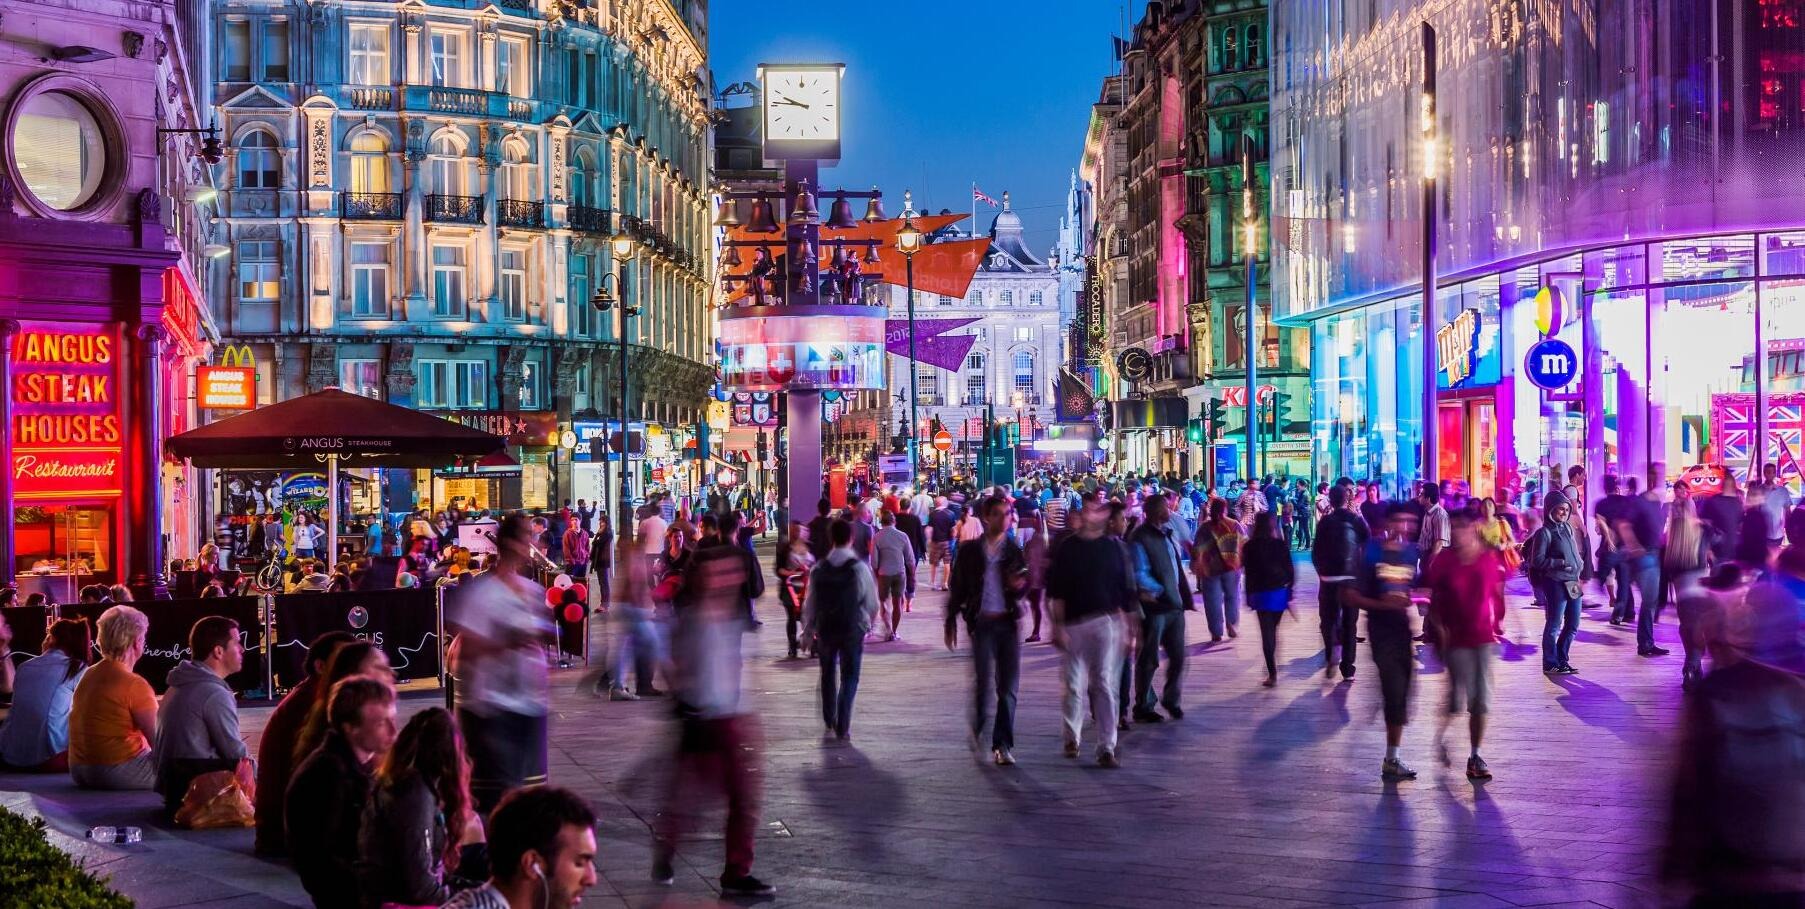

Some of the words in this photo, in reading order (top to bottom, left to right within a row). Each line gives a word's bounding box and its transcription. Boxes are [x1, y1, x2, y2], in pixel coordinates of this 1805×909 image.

[1091, 275, 1101, 334] TROCADERO
[26, 334, 111, 364] ANGUS
[1541, 354, 1568, 374] m
[207, 371, 245, 381] ANGUS
[28, 373, 109, 403] STEAK
[210, 383, 242, 392] STEAK
[205, 395, 247, 405] HOUSES
[21, 414, 119, 443] HOUSES
[300, 438, 343, 448] ANGUS
[15, 455, 115, 479] Restaurant
